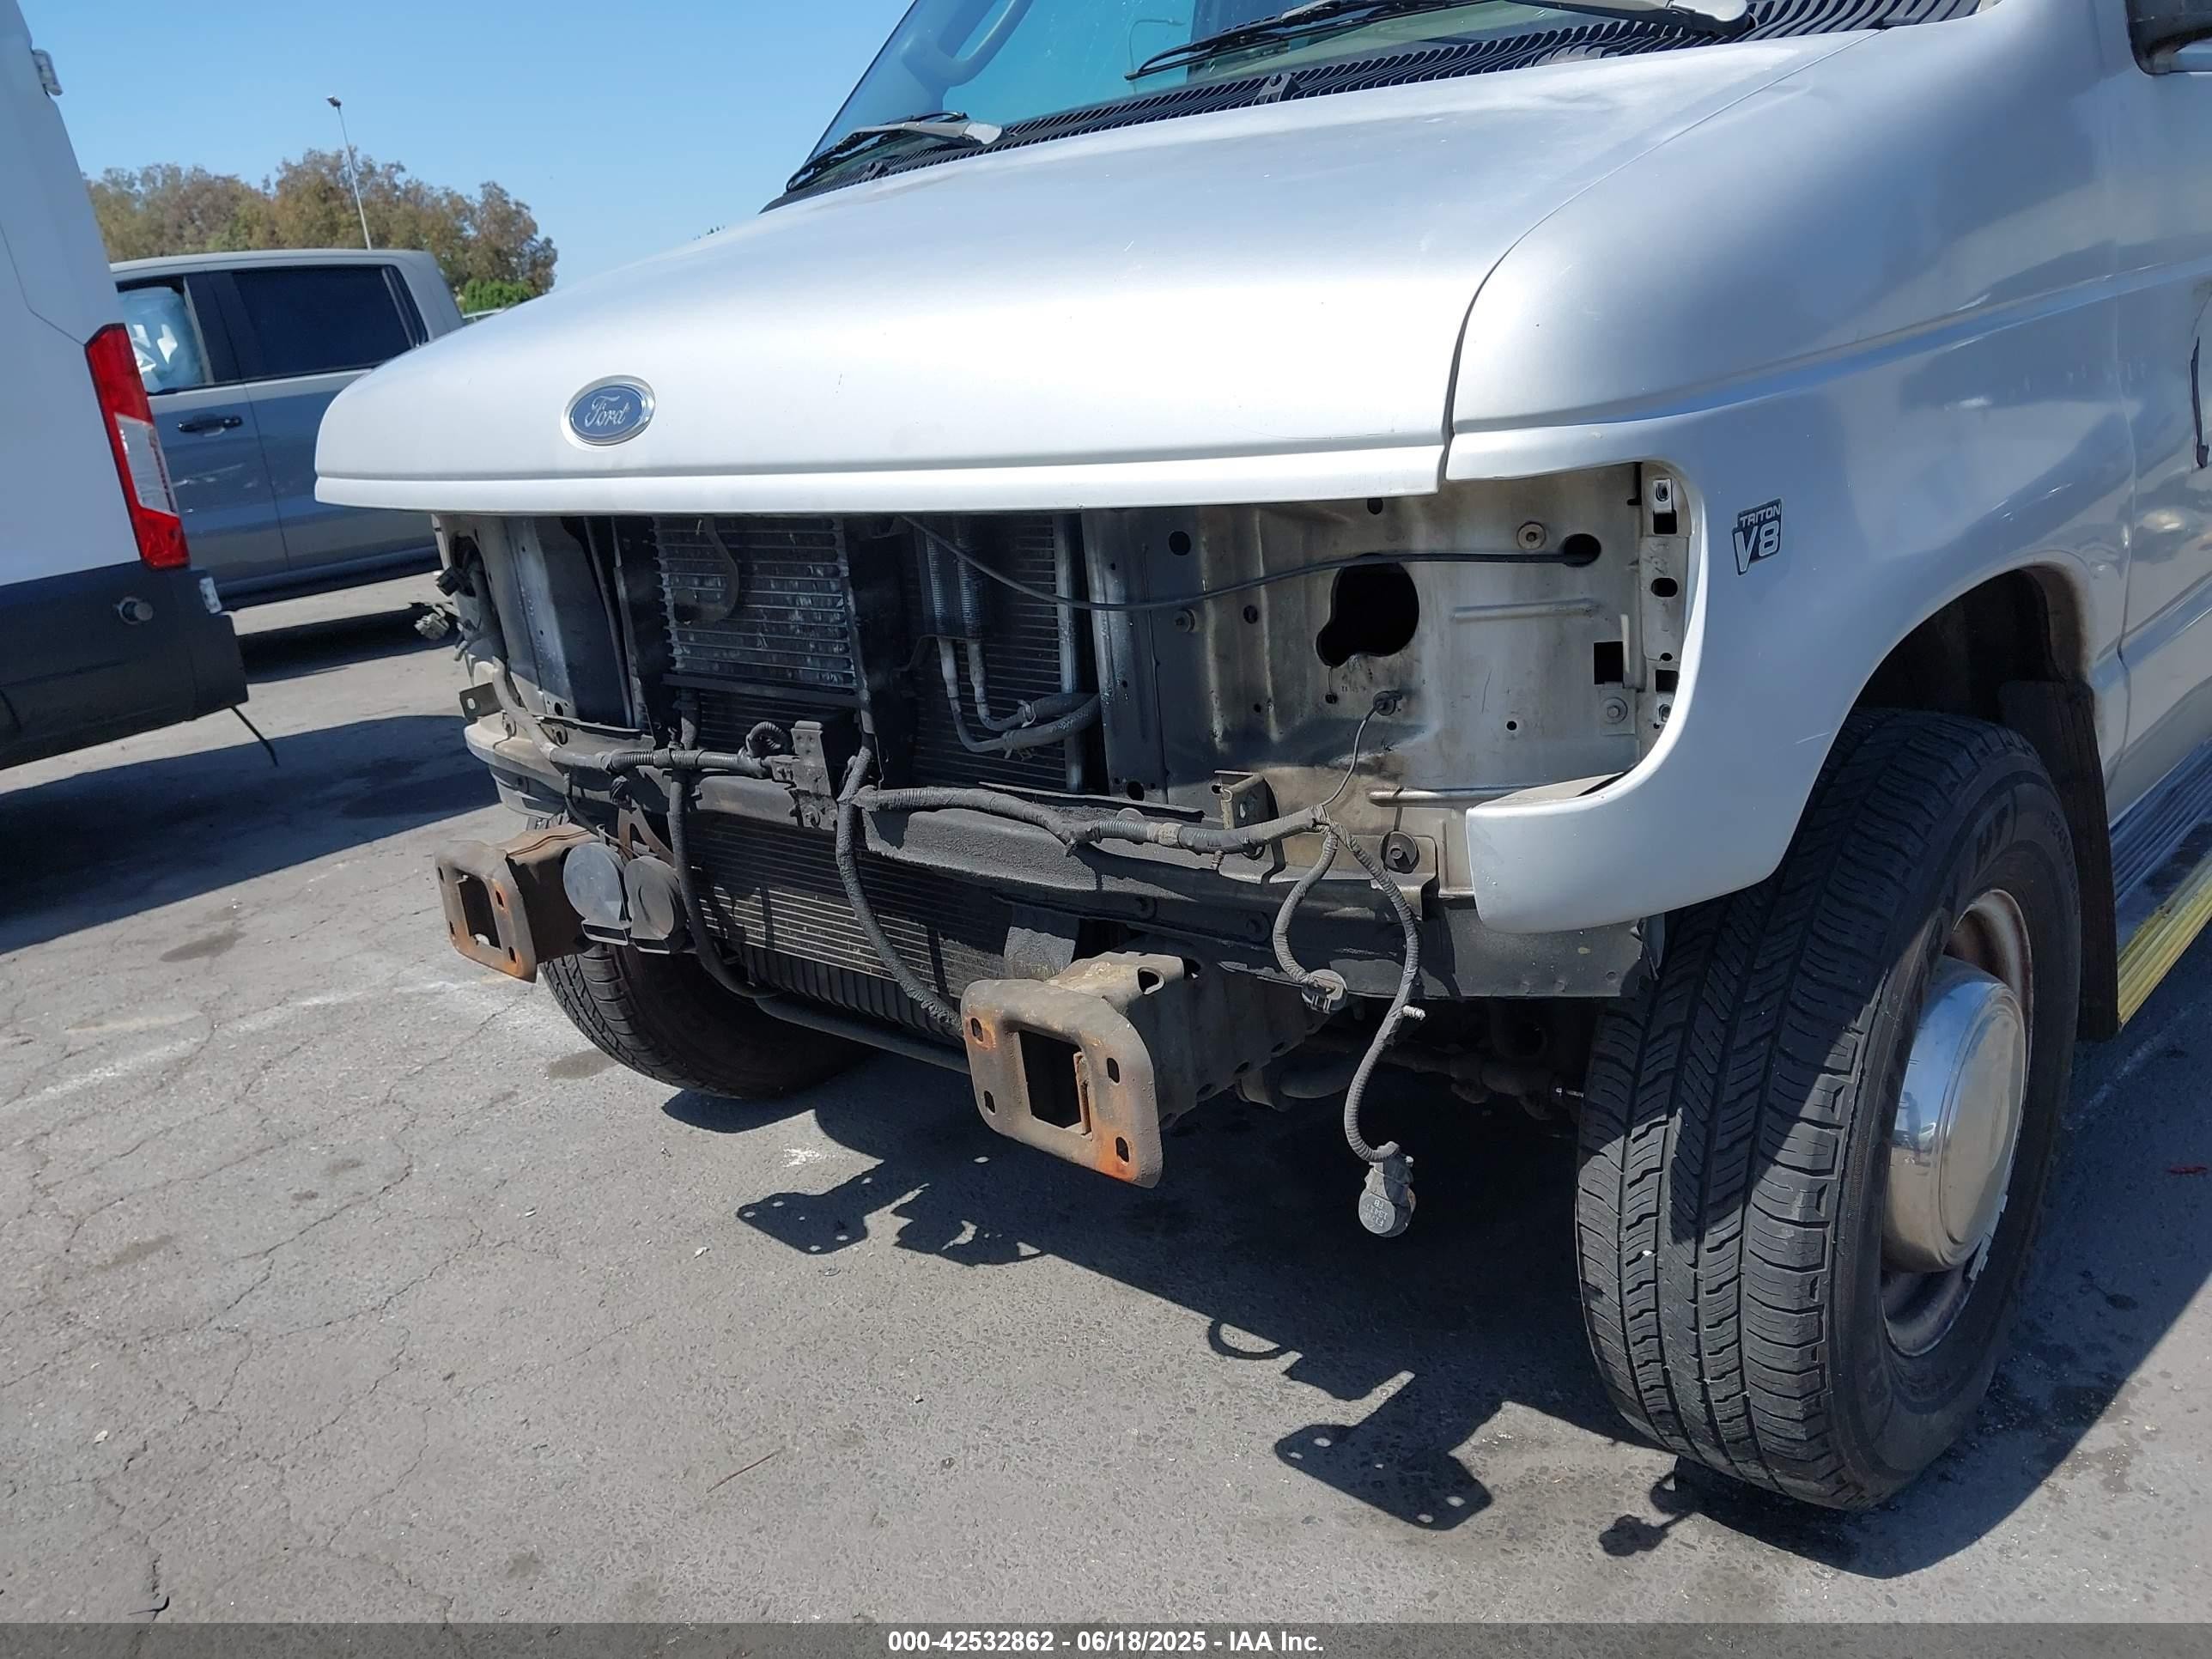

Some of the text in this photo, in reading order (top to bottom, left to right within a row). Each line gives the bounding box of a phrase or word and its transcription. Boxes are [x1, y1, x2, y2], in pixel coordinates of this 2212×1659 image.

[584, 394, 629, 428] Ford
[1739, 503, 1782, 528] TRITON
[1734, 520, 1780, 573] V8
